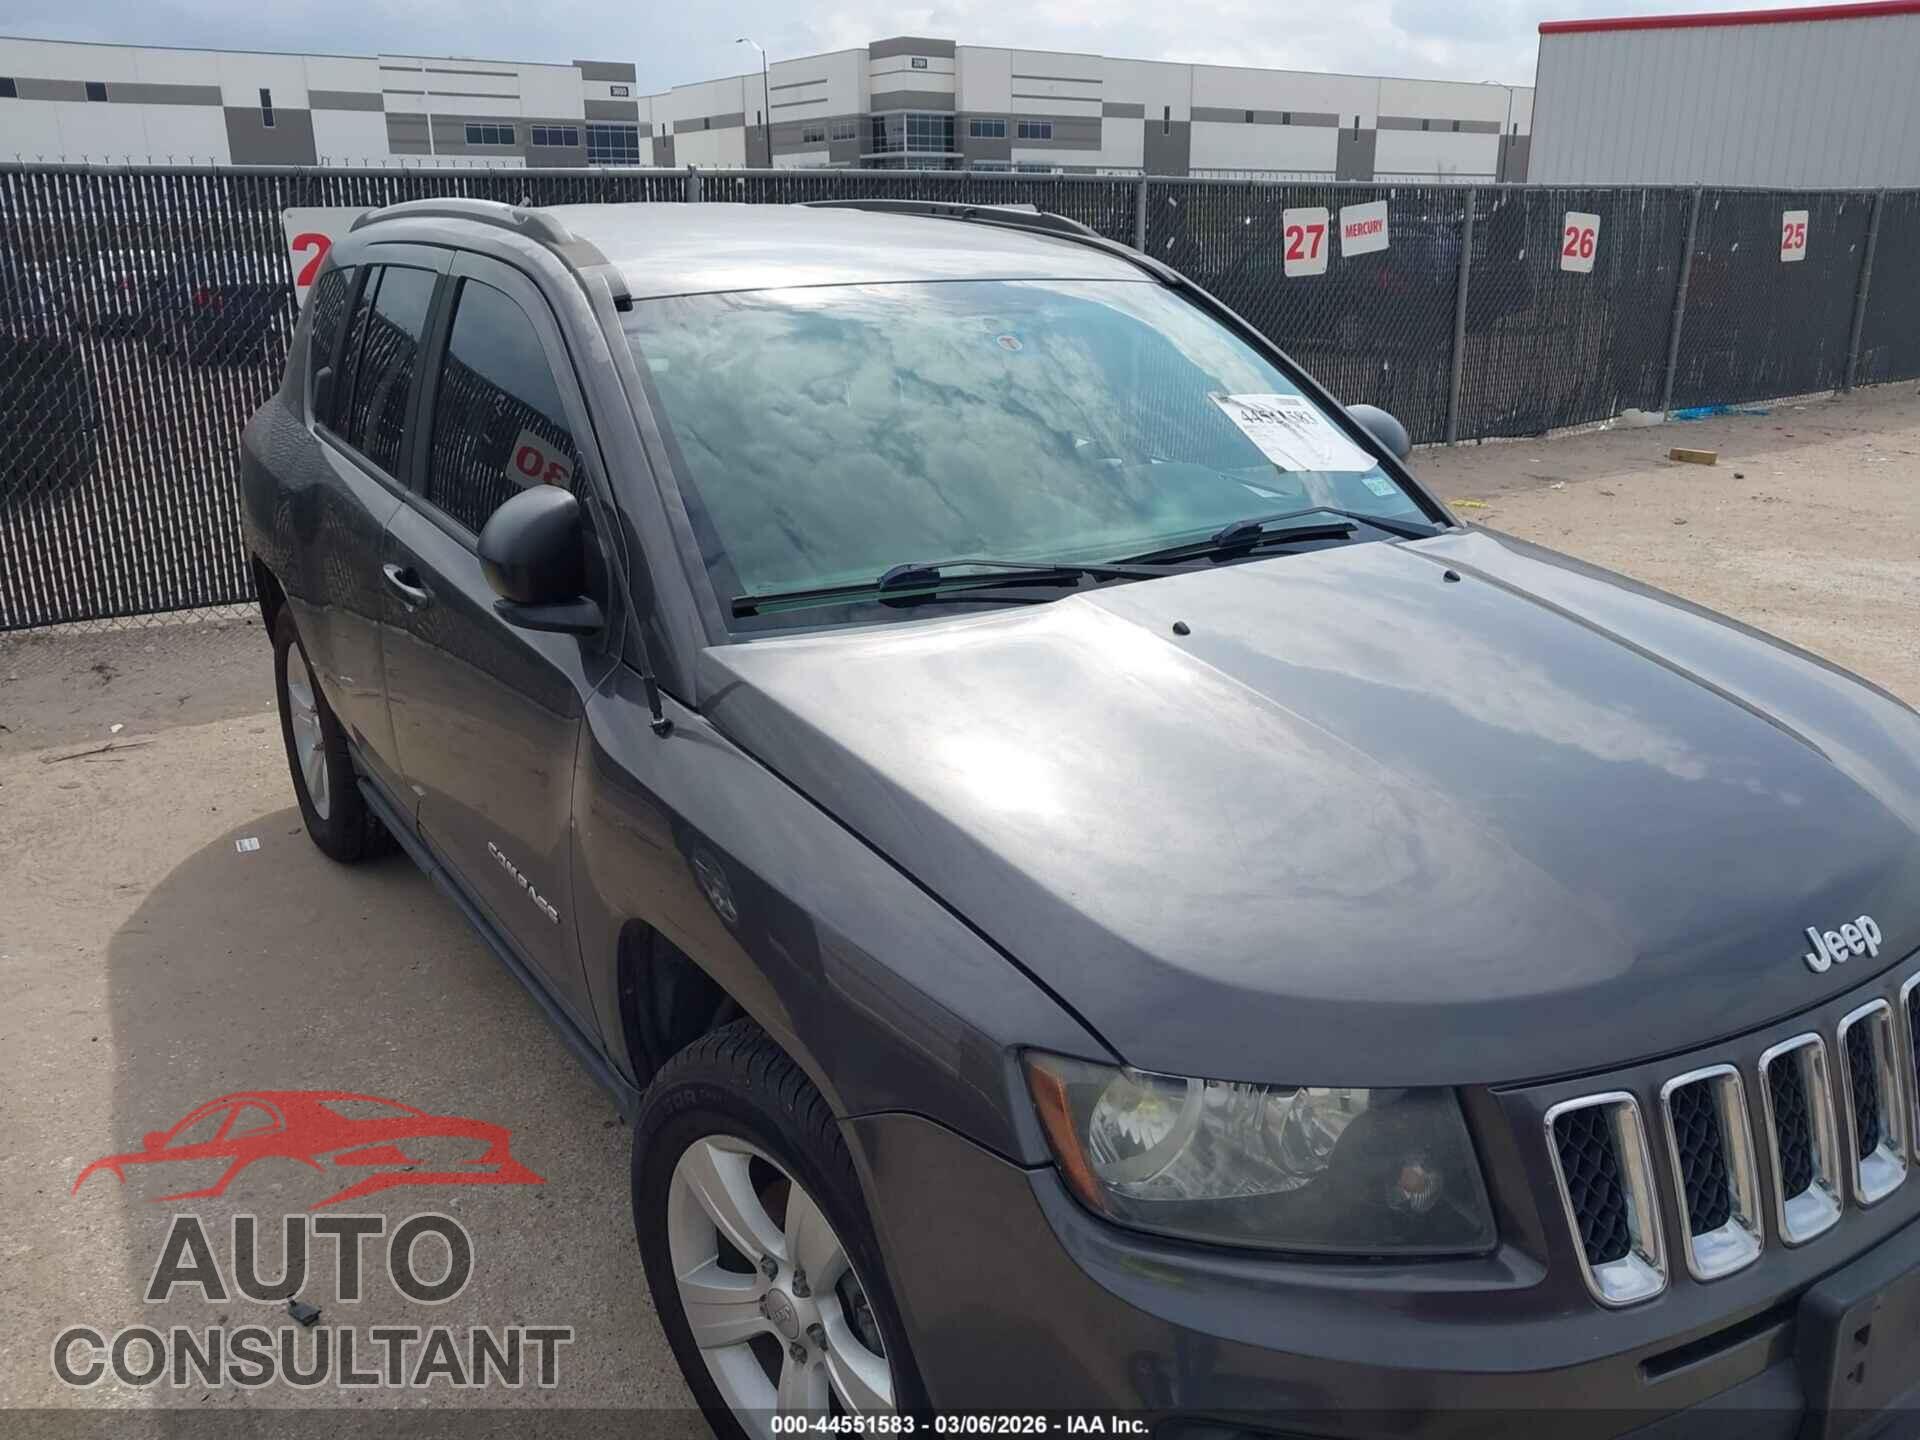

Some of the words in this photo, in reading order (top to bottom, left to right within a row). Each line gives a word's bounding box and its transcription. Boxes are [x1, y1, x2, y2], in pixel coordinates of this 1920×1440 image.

[1286, 224, 1325, 260] 27
[1345, 219, 1384, 238] MERCURY
[1563, 226, 1595, 258] 26
[1782, 223, 1806, 249] 25
[1804, 915, 1882, 973] Jeep
